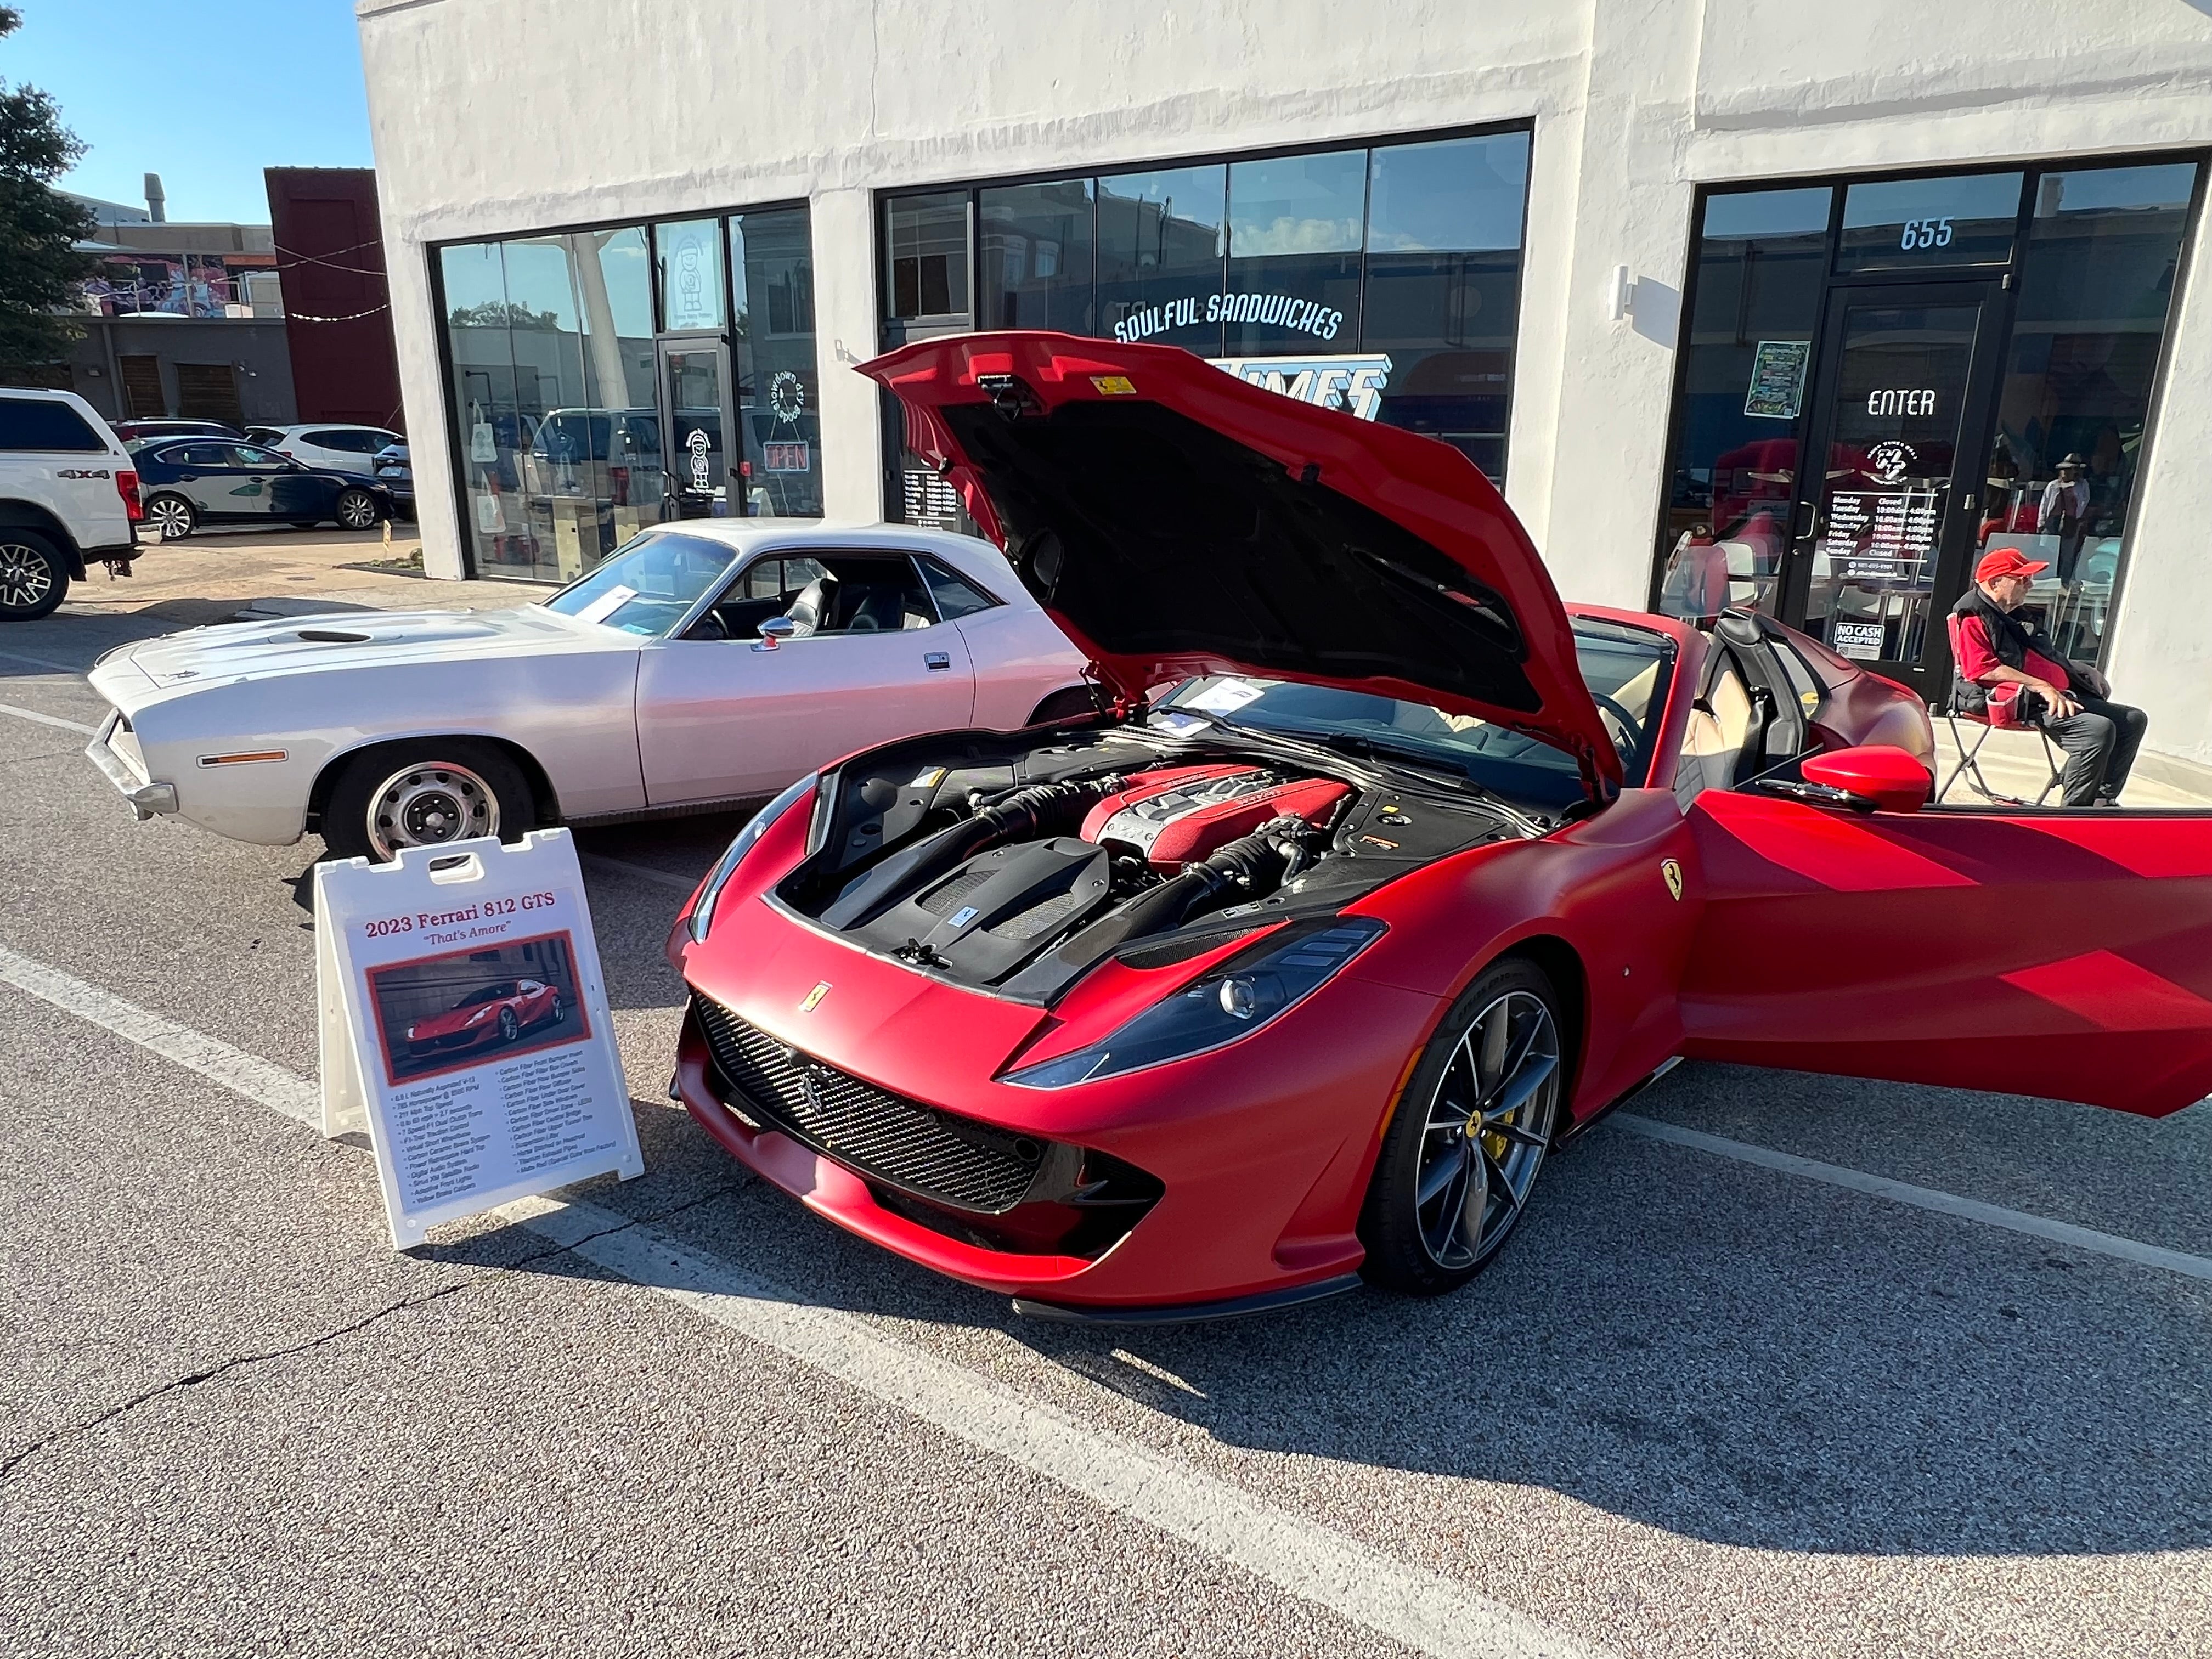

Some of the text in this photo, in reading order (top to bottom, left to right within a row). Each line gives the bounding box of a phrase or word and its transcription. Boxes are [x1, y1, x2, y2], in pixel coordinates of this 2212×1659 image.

[1900, 215, 1954, 250] 655
[1115, 297, 1200, 343] SOULFUL
[1206, 294, 1343, 340] SANDWICHES
[770, 371, 804, 424] slowdown dry goods
[1867, 388, 1936, 416] ENTER
[1837, 635, 1880, 645] ACCEPTED
[1838, 625, 1882, 637] NO CASH
[365, 892, 555, 938] 2023 Ferrari 812 GTS
